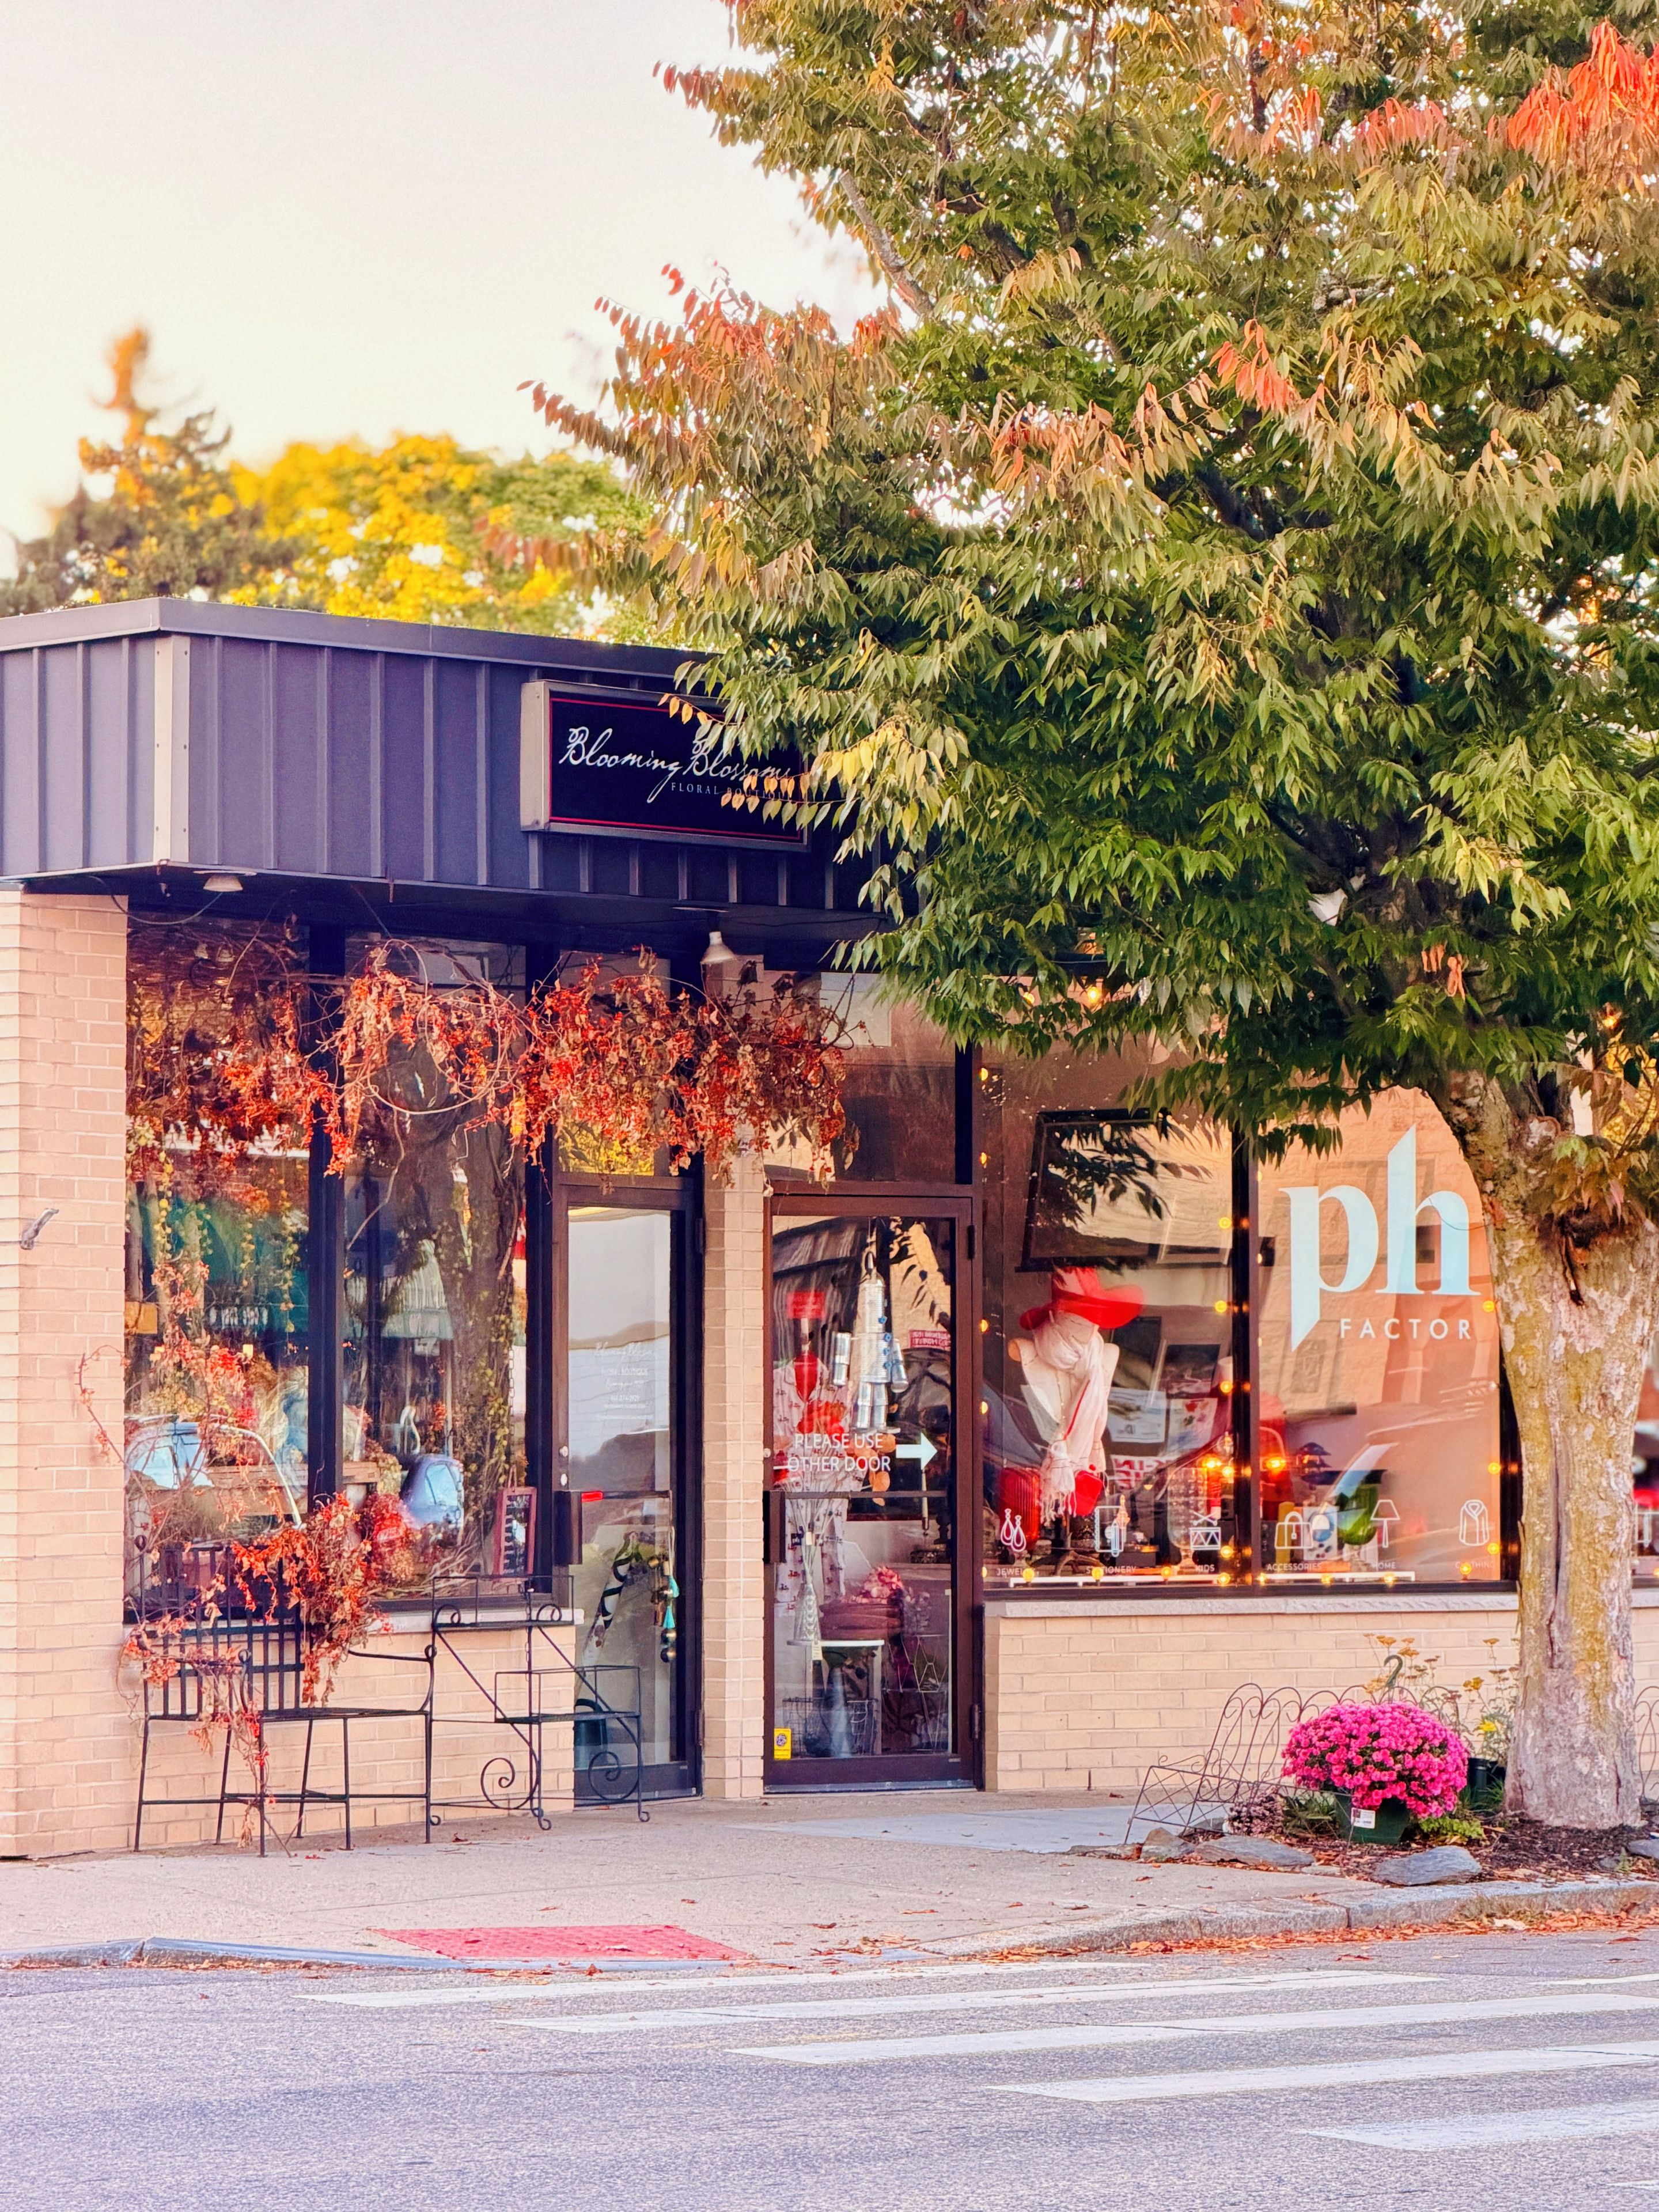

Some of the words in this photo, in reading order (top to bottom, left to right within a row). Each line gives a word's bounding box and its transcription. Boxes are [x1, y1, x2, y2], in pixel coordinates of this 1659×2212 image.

[558, 726, 683, 804] Blooming
[671, 782, 719, 795] FLORAL
[1278, 1123, 1481, 1353] ph
[1340, 1319, 1472, 1340] FACTOR
[794, 1433, 849, 1449] PLEASE
[854, 1433, 883, 1449] USE
[787, 1456, 839, 1472] OTHER
[845, 1456, 891, 1472] DOOR
[1195, 1564, 1215, 1572] KIDS
[1267, 1563, 1322, 1571] ACCESSORIES
[1370, 1562, 1396, 1570] HOME
[1455, 1560, 1494, 1570] CTHING
[996, 1567, 1036, 1577] JEWEL
